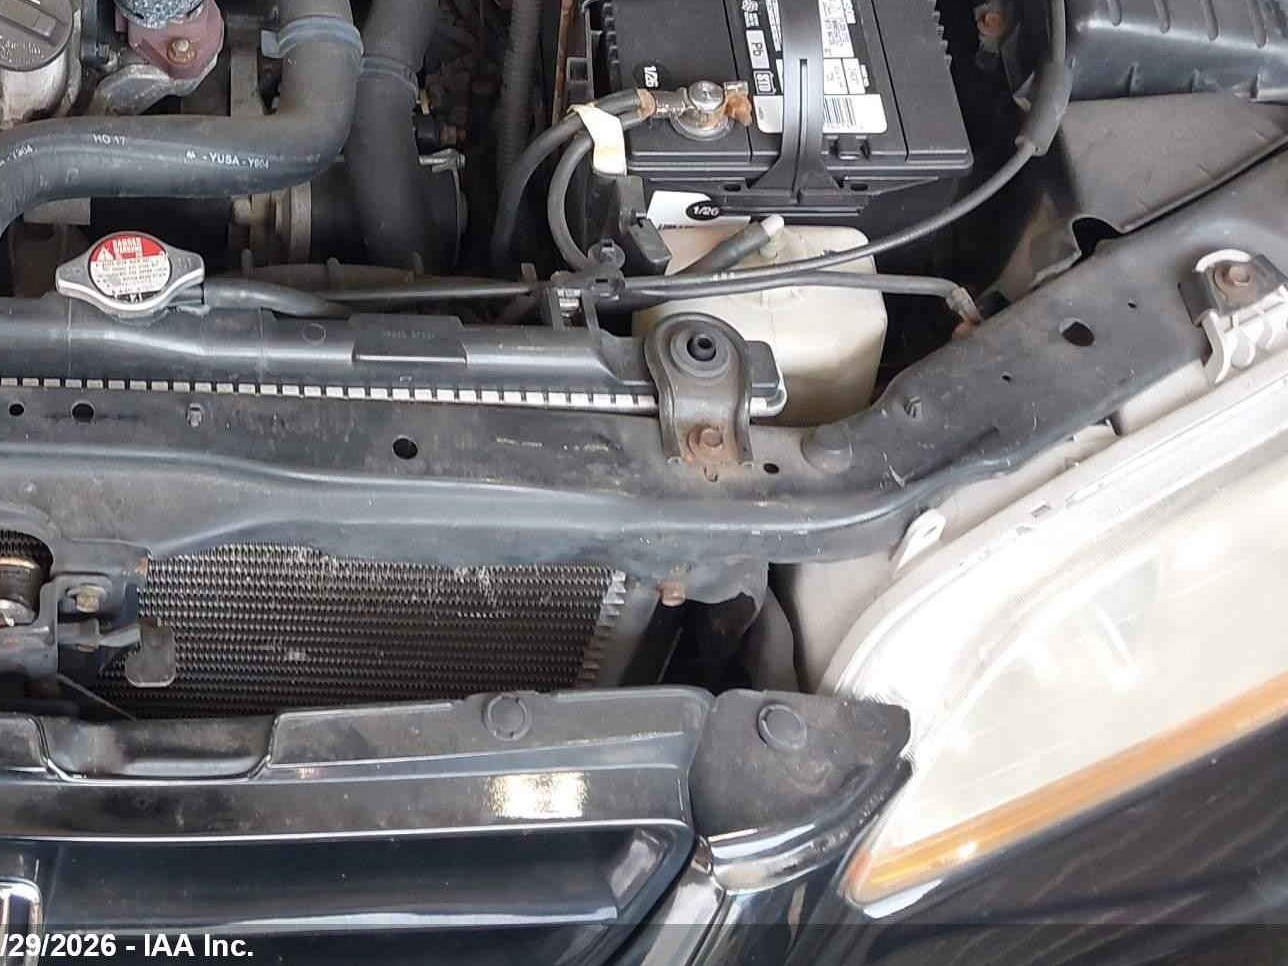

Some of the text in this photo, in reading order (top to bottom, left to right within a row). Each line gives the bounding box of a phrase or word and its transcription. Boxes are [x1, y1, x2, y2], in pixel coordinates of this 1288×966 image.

[751, 42, 763, 57] Pb
[643, 65, 659, 88] 1/26
[209, 151, 240, 166] YUSA
